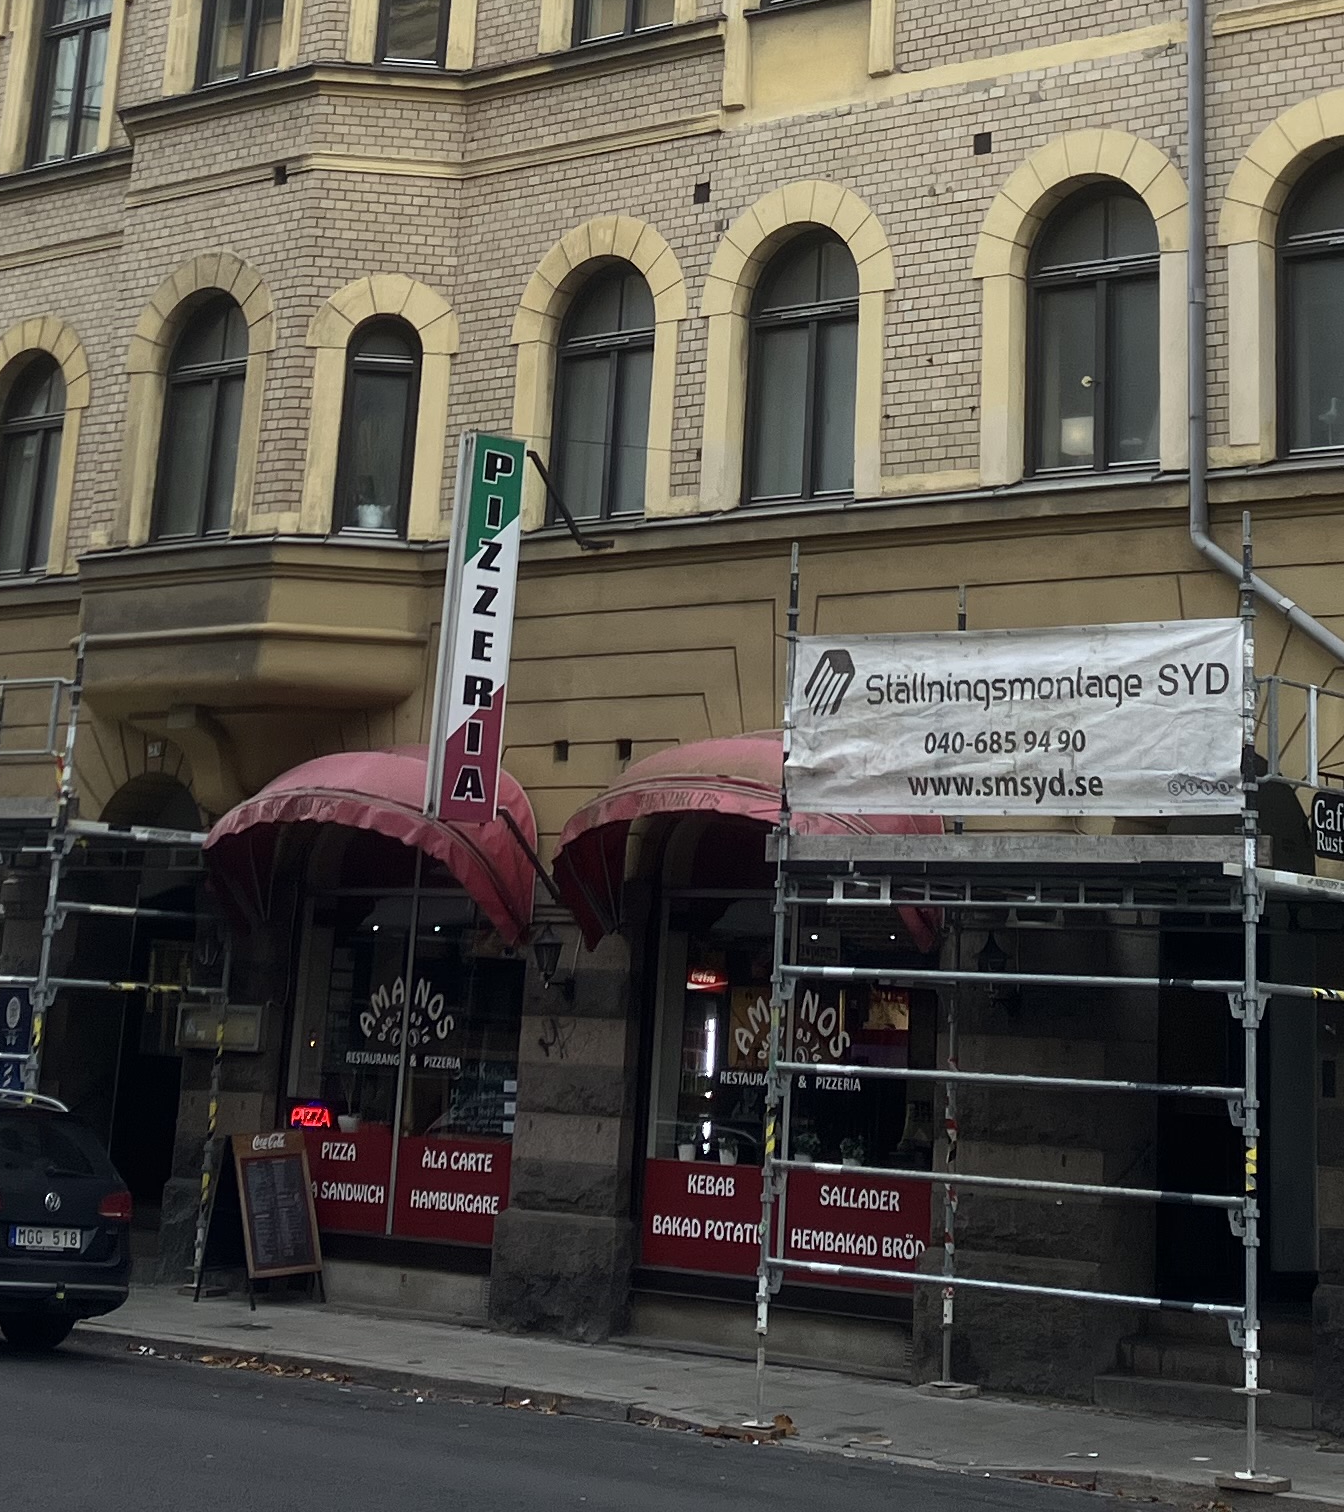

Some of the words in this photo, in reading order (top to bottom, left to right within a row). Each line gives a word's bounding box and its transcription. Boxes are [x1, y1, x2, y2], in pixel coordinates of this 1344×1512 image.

[451, 449, 514, 803] PIZZERIA
[866, 667, 1143, 711] Ställningsmontage
[1158, 662, 1230, 696] SYD
[924, 732, 1017, 754] 040-685
[1023, 731, 1051, 753] 94
[1057, 730, 1086, 753] 90
[908, 768, 1104, 804] www.smsyd.se
[346, 1051, 400, 1065] RESTAURANG
[424, 1056, 461, 1069] PIZZERIA
[798, 1077, 806, 1088] &
[816, 1077, 861, 1091] PIZZERIA
[291, 1107, 330, 1128] PIZZA
[322, 1142, 356, 1161] PIZZA
[451, 1151, 493, 1172] CARTE
[320, 1181, 384, 1204] SANDWICH
[687, 1174, 735, 1197] KEBAB
[411, 1190, 499, 1215] HAMBURGARE
[820, 1185, 900, 1212] SALLADER
[18, 1229, 43, 1244] MGG
[52, 1230, 77, 1246] 518
[652, 1215, 700, 1238] BAKAD
[791, 1228, 878, 1256] HEMBAKAD
[882, 1233, 926, 1260] BRÖD
